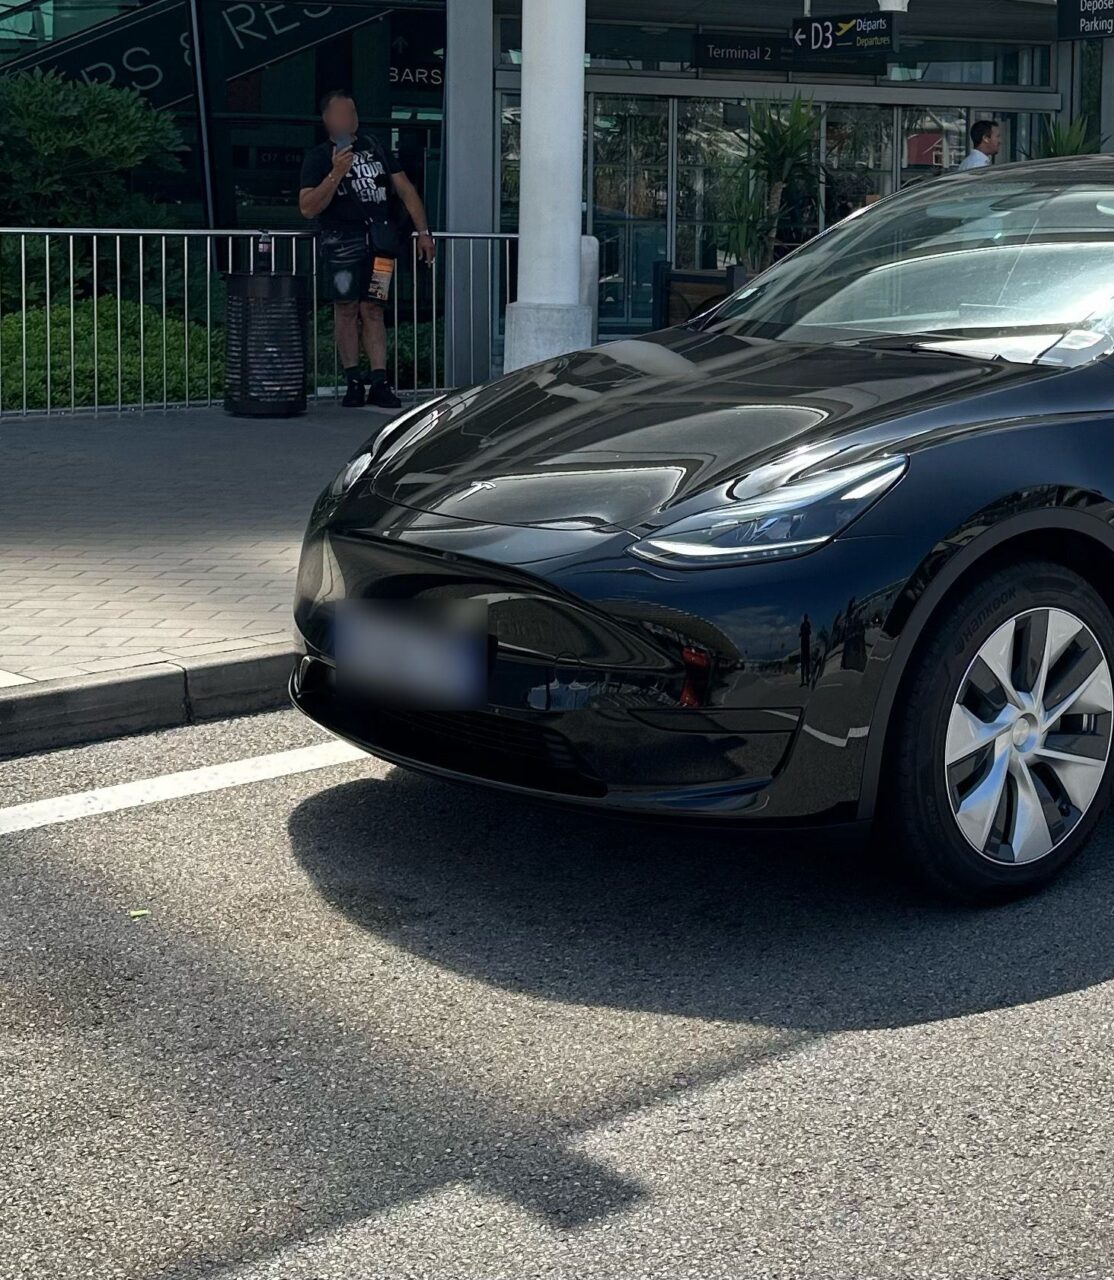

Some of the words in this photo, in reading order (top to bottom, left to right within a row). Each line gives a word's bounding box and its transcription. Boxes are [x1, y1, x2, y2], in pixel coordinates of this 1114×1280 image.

[856, 18, 887, 33] Départs
[1080, 16, 1113, 34] Parking
[811, 21, 833, 49] D3
[707, 44, 760, 60] Terminal
[764, 47, 772, 60] 2
[389, 67, 442, 84] BARS
[352, 161, 386, 178] YOUR
